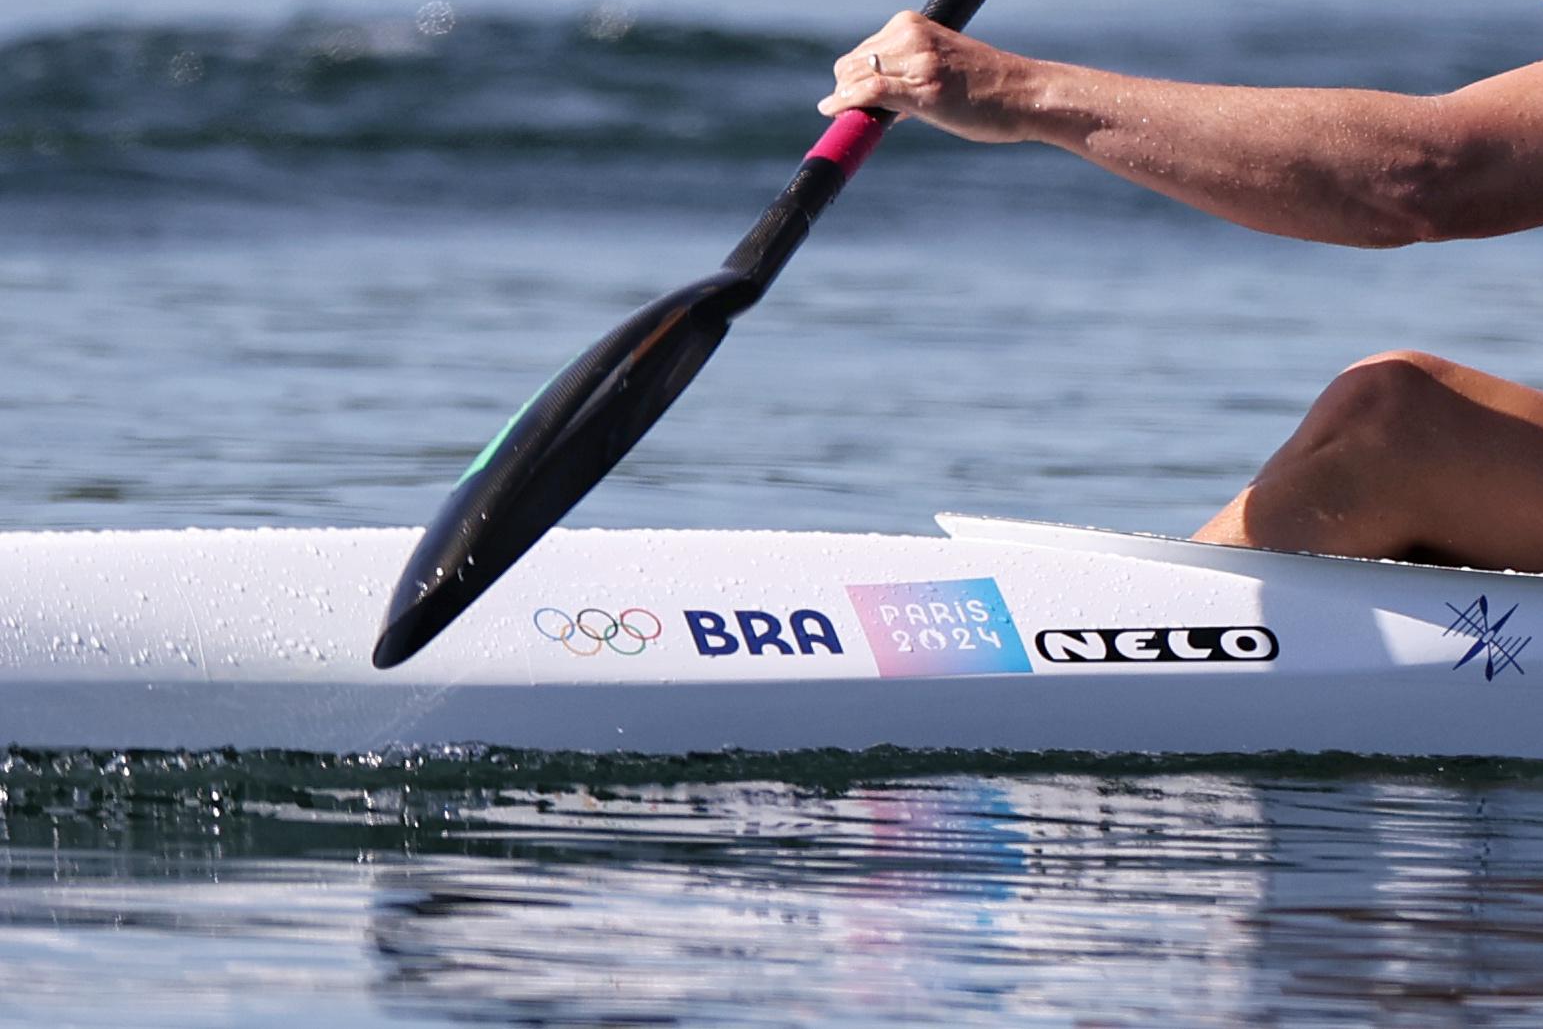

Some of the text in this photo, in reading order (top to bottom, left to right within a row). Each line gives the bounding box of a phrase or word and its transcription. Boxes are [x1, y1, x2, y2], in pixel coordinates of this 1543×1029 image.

[879, 599, 989, 626] PARIS
[683, 608, 845, 656] BRA
[891, 626, 1002, 652] 2024
[1044, 629, 1273, 661] NELO
